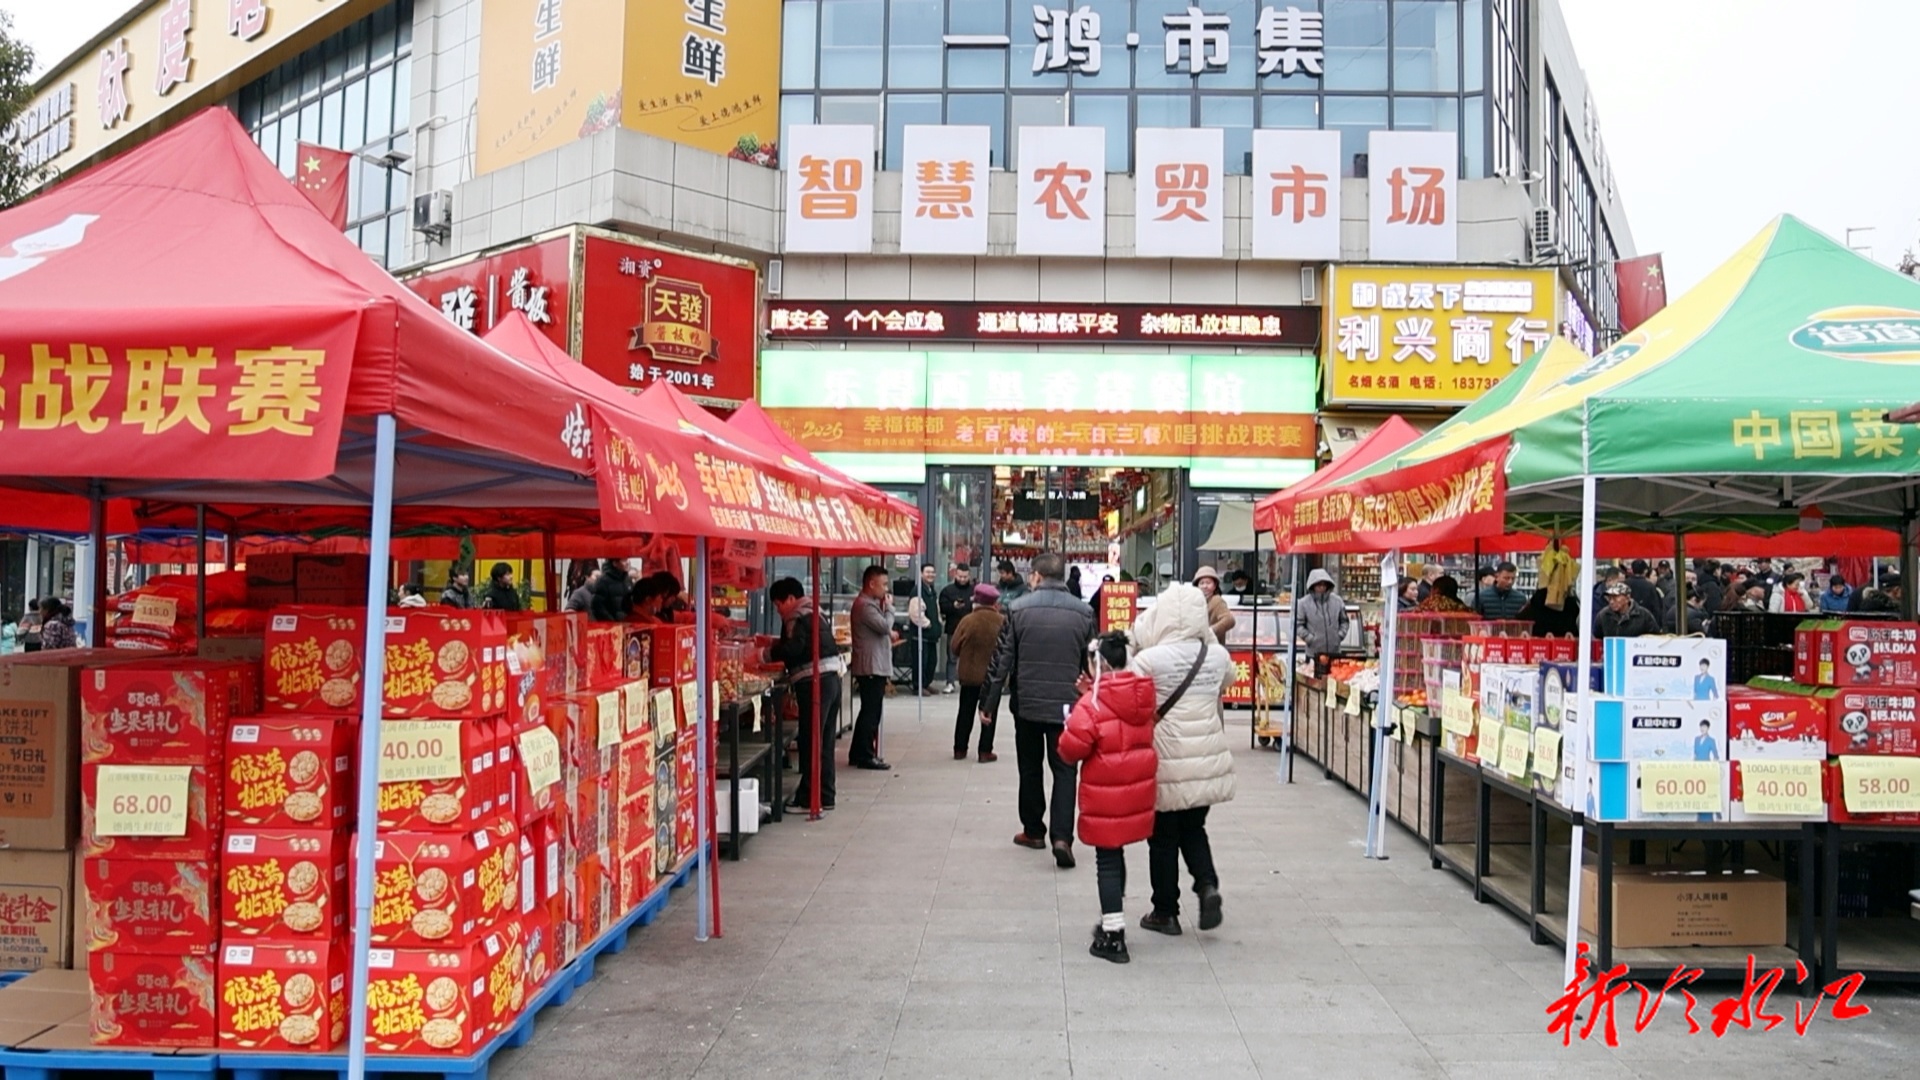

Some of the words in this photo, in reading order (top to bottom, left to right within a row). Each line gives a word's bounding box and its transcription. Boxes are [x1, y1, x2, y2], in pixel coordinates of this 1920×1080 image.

[532, 0, 564, 92] 生鲜
[682, 0, 727, 86] 生鲜
[798, 154, 1446, 227] 智慧农贸市场
[844, 309, 945, 331] 个个会应急
[977, 311, 1119, 334] 通道畅通保平安
[1140, 313, 1282, 336] 杂物乱放埋隐患
[1808, 321, 1920, 346] 道道
[1337, 314, 1550, 365] 利兴商行
[0, 343, 327, 437] 战联赛
[21, 708, 50, 719] GIFT
[109, 706, 179, 735] 坚果有礼
[382, 738, 443, 761] 40.00
[230, 747, 286, 785] 福满
[1746, 764, 1777, 774] 100AD
[237, 775, 290, 810] 桃酥
[1655, 779, 1707, 795] 60.00
[1756, 780, 1808, 797] 40.00
[1858, 778, 1911, 794] 58.00
[112, 794, 172, 815] 68.00
[226, 858, 285, 896] 福满
[113, 897, 184, 923] 坚果有礼
[234, 888, 288, 921] 桃酥
[118, 989, 188, 1015] 坚果有礼
[223, 969, 281, 1007] 福满
[231, 1000, 286, 1033] 桃酥
